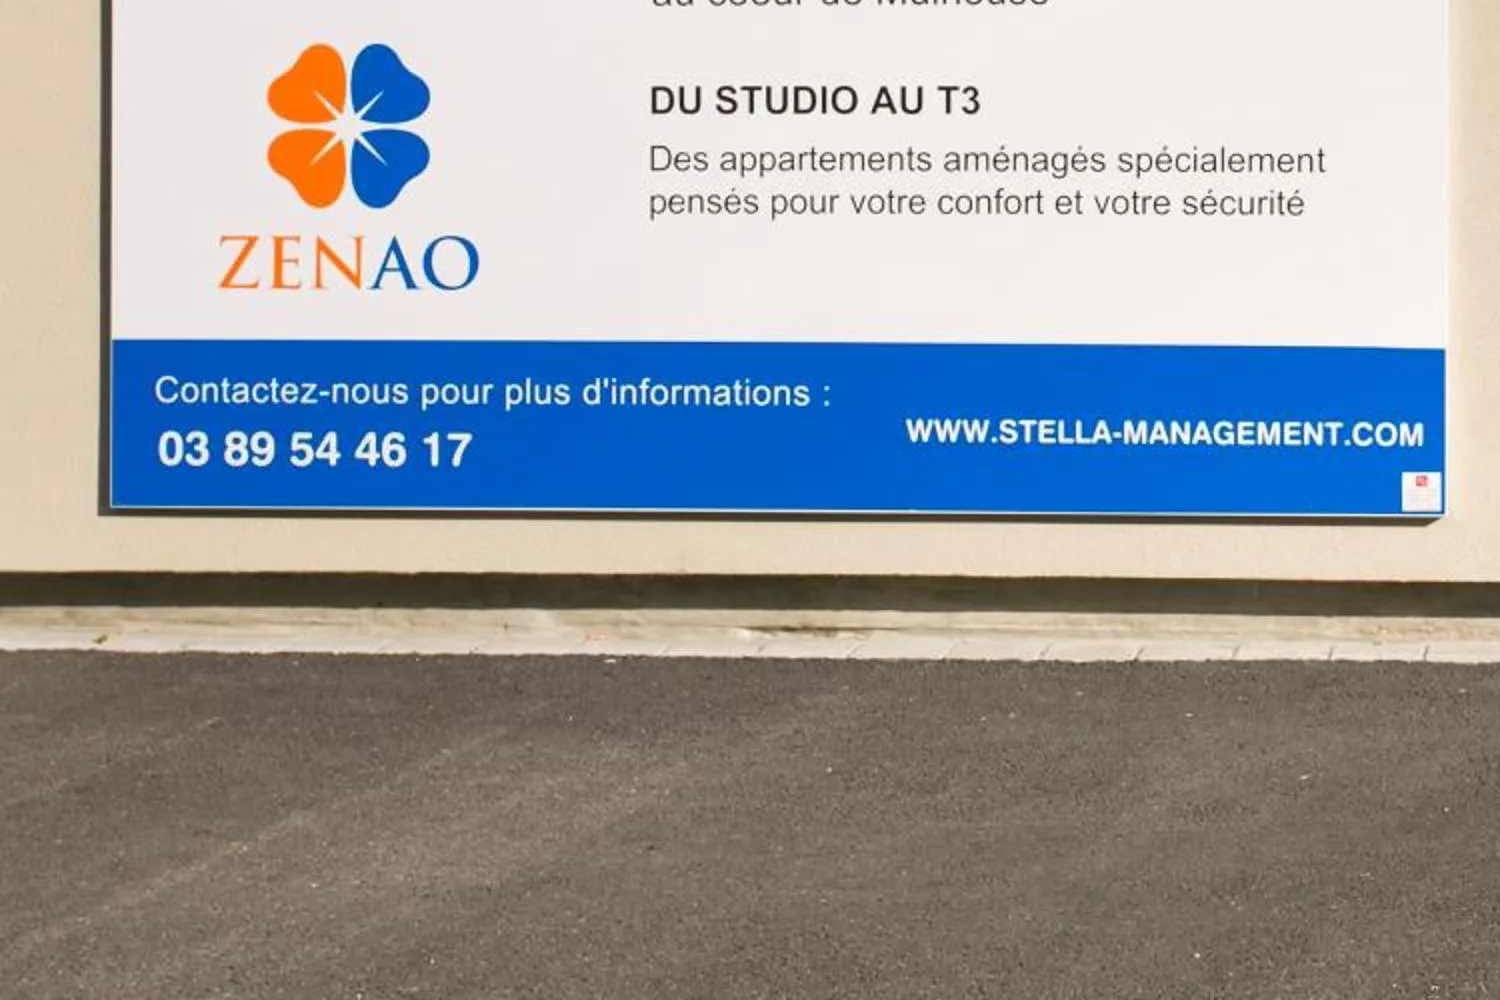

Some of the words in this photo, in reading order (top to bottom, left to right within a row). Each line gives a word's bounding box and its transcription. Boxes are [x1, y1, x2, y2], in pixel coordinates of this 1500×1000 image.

[650, 85, 702, 116] DU
[715, 85, 859, 116] STUDIO
[870, 85, 924, 116] AU
[936, 85, 981, 116] T3
[649, 144, 709, 173] Des
[719, 146, 933, 179] appartements
[943, 145, 1107, 180] aménagés
[1117, 145, 1327, 179] spécialement
[649, 187, 760, 221] pensés
[771, 193, 841, 221] pour
[849, 189, 927, 215] votre
[937, 187, 1045, 215] confort
[1054, 190, 1084, 216] et
[1093, 190, 1171, 216] votre
[1182, 188, 1305, 217] sécurité
[218, 234, 480, 292] ZENAO
[153, 375, 409, 407] Contactez-nous
[419, 382, 495, 412] pour
[503, 376, 571, 412] plus
[581, 376, 811, 408] d'informations
[157, 430, 211, 469] 03
[223, 430, 276, 469] 89
[287, 430, 342, 468] 54
[353, 431, 408, 468] 46
[422, 431, 473, 468] 17
[903, 416, 1425, 449] WWW.STELLA-MANAGEMENT.COM
